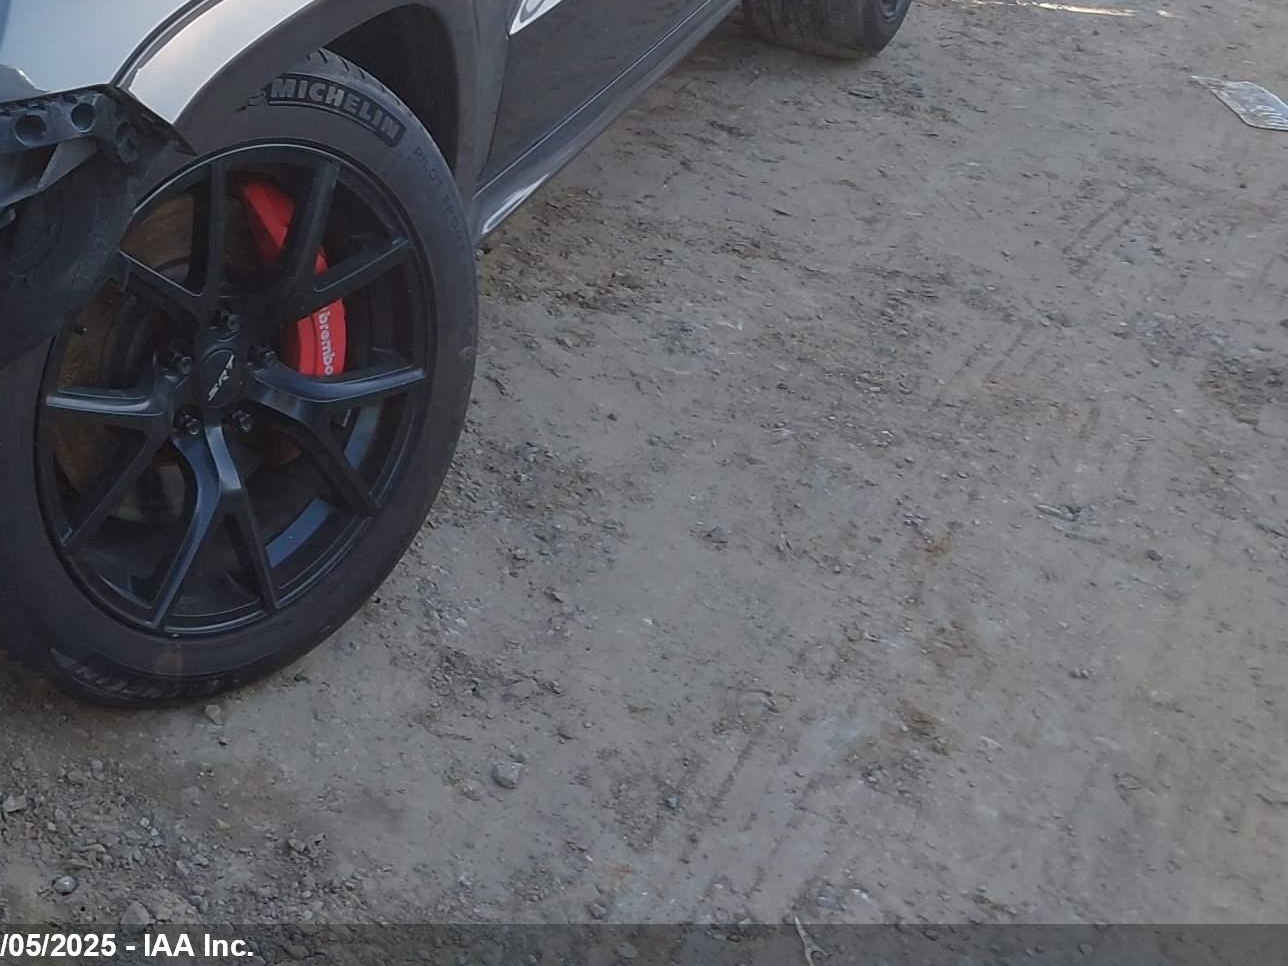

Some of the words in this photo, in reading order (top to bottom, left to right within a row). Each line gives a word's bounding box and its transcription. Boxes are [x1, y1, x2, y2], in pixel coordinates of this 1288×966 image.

[269, 76, 401, 140] MICHELIN
[413, 145, 444, 187] PILOT
[317, 310, 336, 376] brembo
